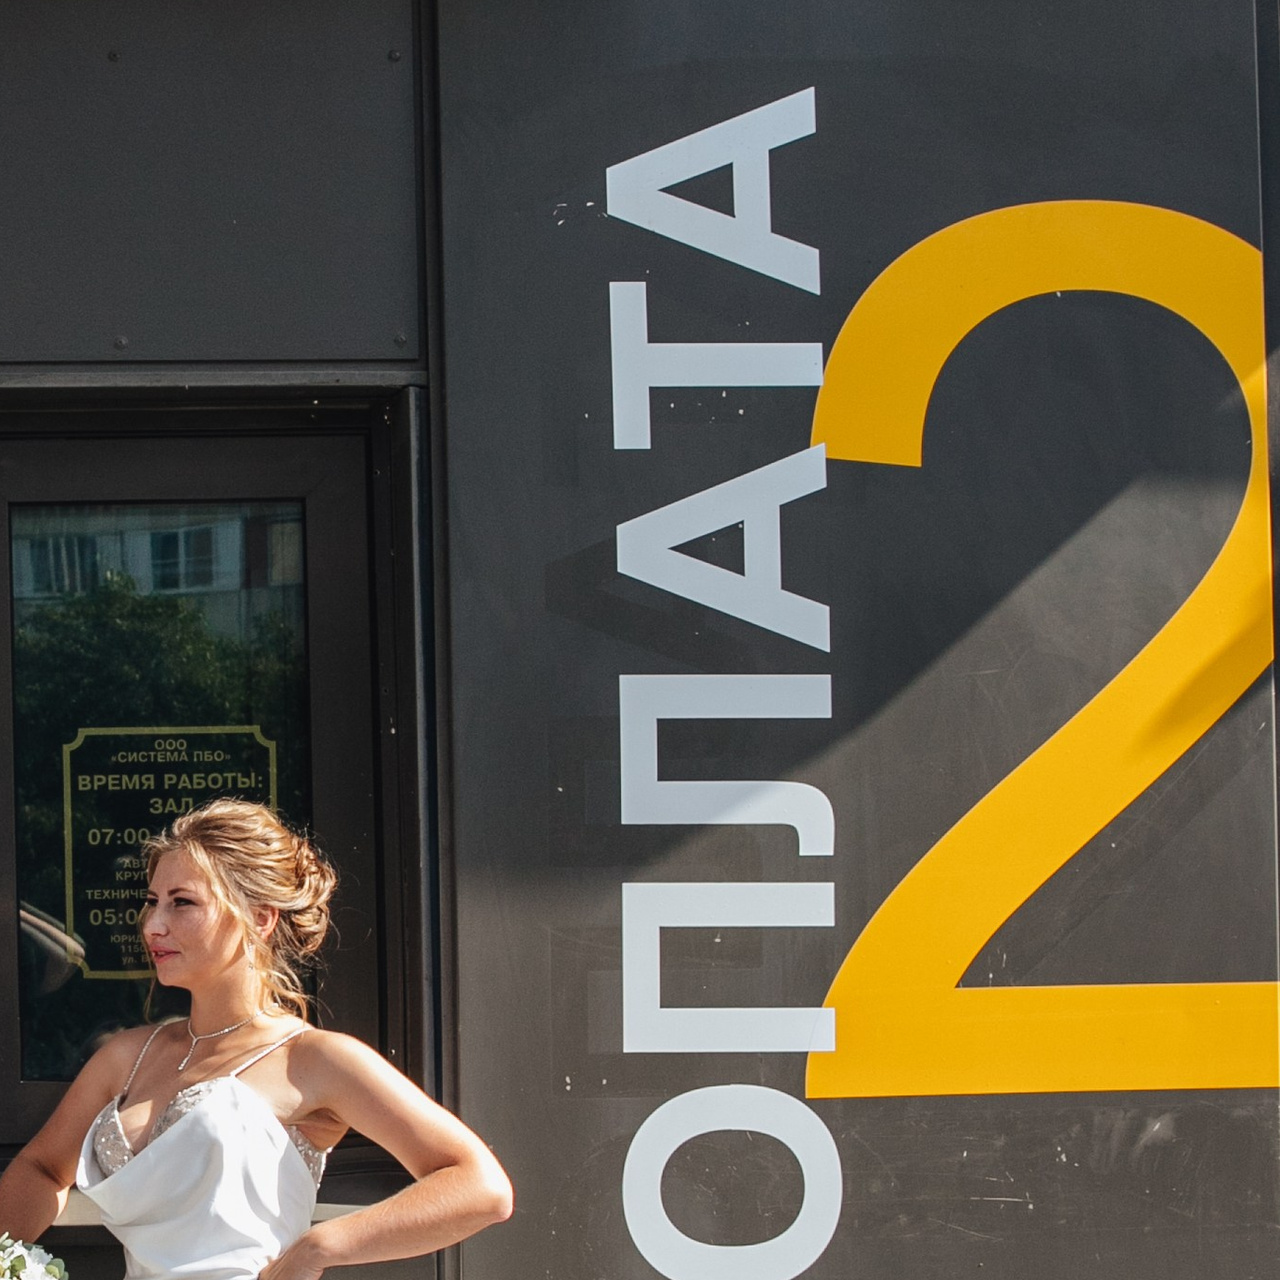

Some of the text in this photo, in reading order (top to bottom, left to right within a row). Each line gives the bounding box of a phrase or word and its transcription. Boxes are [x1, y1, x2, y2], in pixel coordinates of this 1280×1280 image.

[805, 199, 1280, 1098] 2
[154, 739, 187, 751] ООО
[111, 750, 231, 763] «СИСТЕМА ПБО»
[77, 772, 264, 791] ВРЕМЯ РАБОТЫ:
[149, 797, 194, 814] ЗАЛ
[87, 827, 151, 846] 07:00
[85, 888, 148, 900] ТЕХНИЧЕ
[89, 908, 139, 926] 05:0
